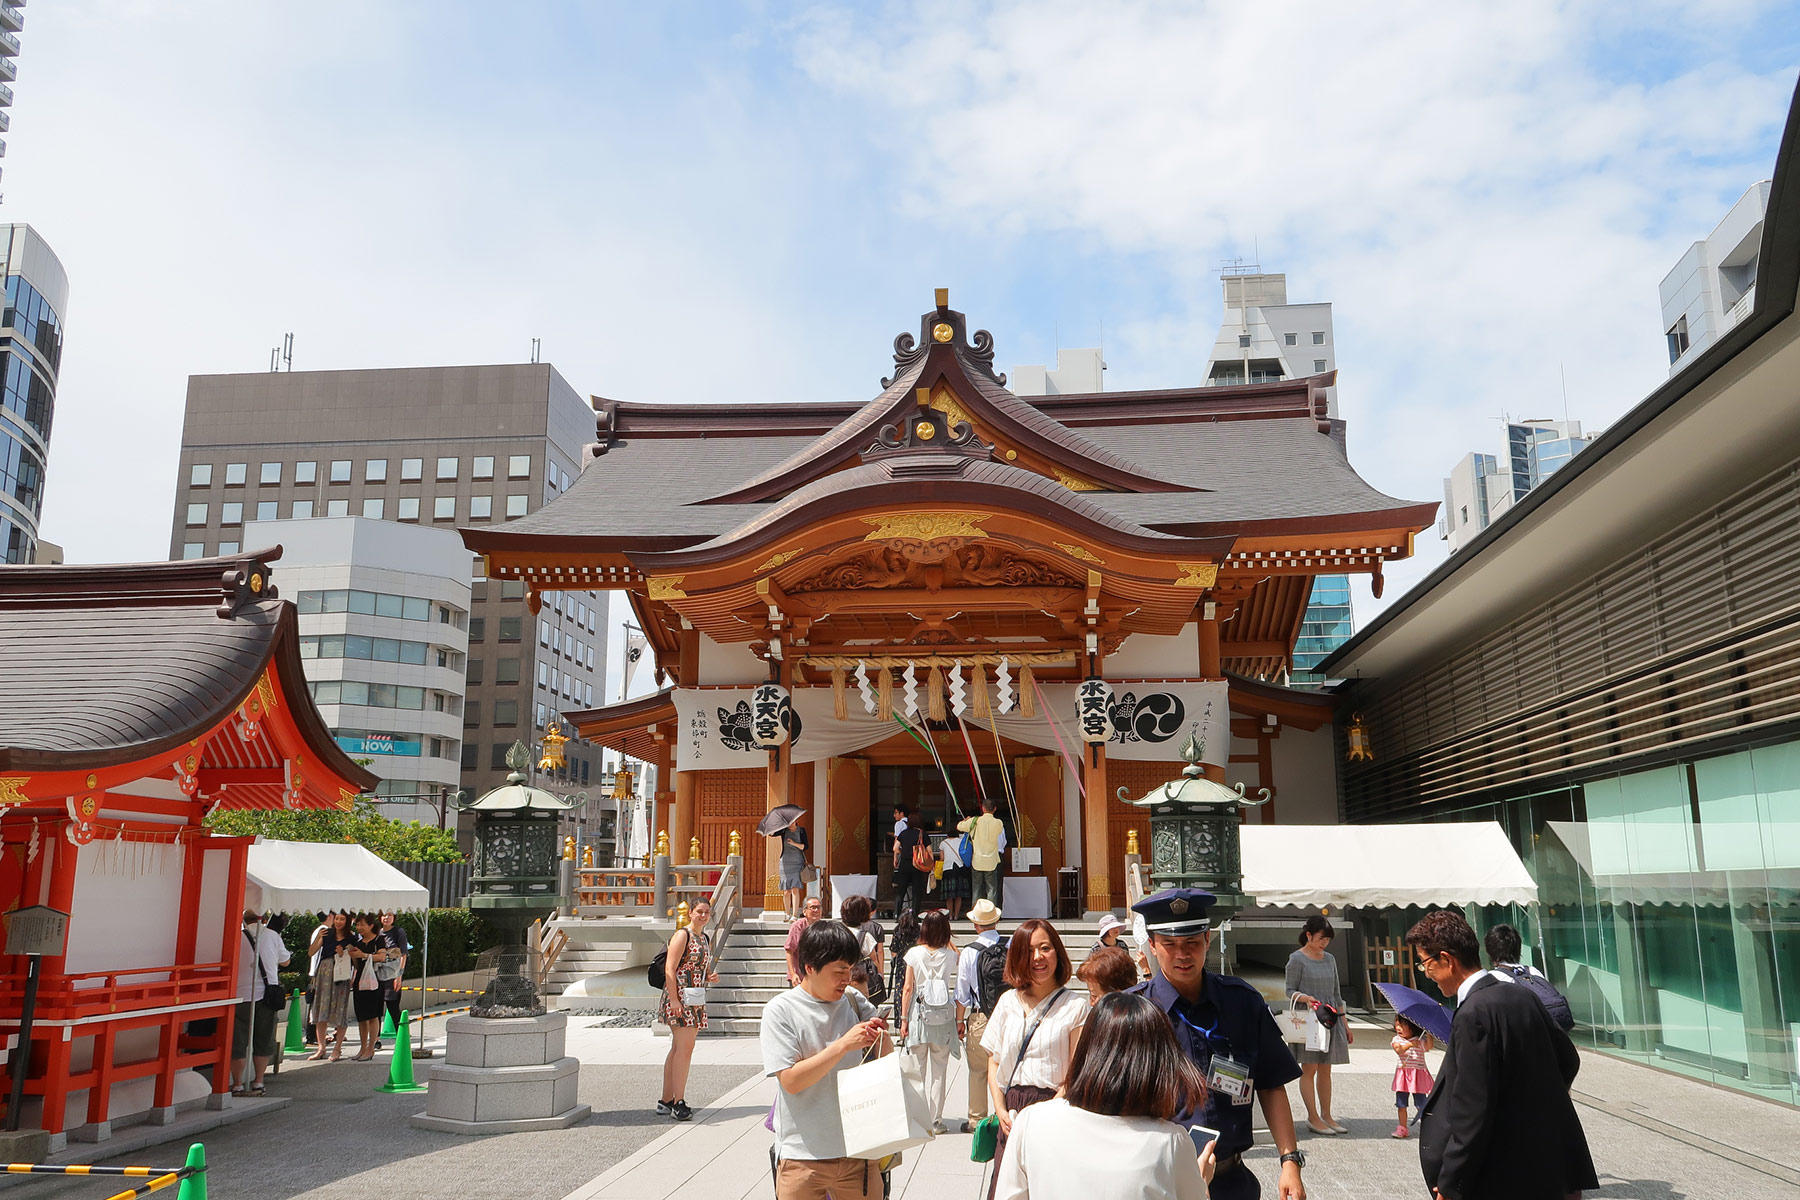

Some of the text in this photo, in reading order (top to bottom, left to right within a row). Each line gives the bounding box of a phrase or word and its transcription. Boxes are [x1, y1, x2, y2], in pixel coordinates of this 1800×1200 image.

[754, 686, 780, 740] 水天宮
[1080, 681, 1107, 736] 水天宮
[361, 741, 394, 752] NOVA
